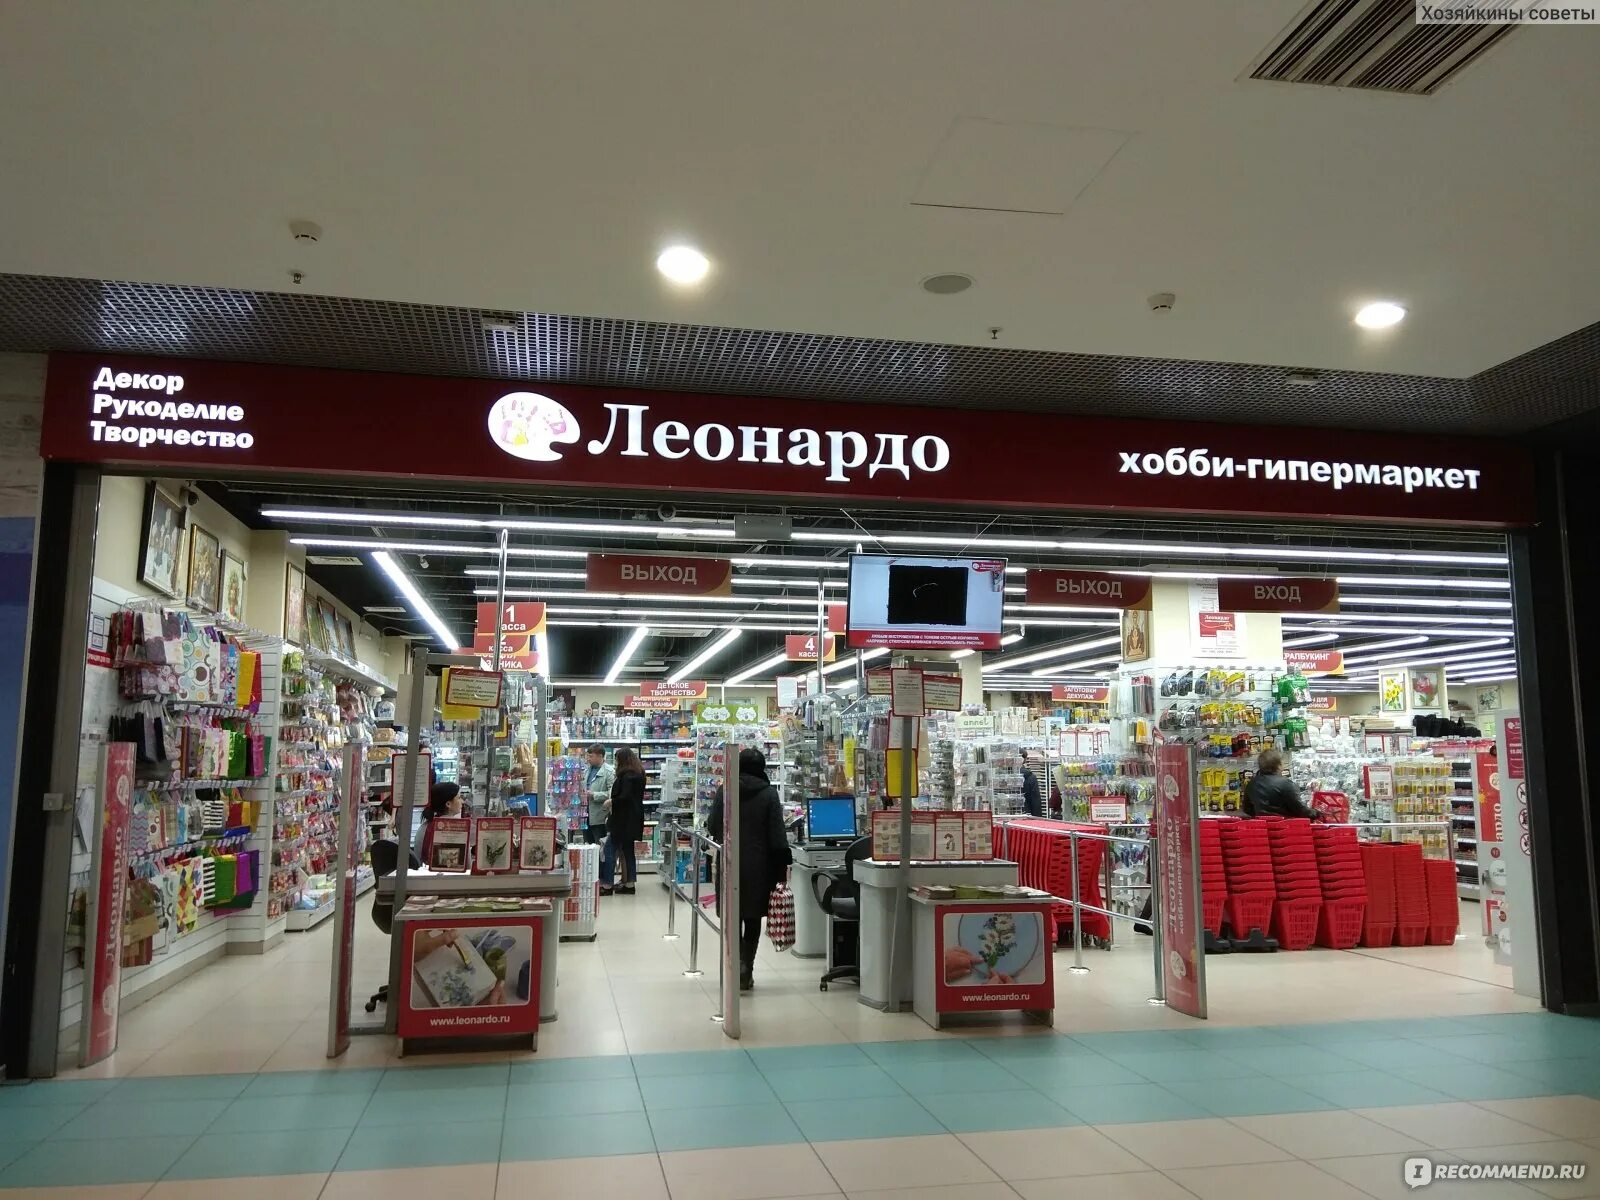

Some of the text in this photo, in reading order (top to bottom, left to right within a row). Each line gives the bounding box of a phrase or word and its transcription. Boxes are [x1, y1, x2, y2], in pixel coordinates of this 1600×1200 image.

[93, 366, 185, 395] Декор
[93, 393, 245, 422] Рукоделие
[90, 420, 255, 449] Творчество
[587, 402, 950, 482] Леонардо
[1118, 447, 1481, 493] хобби-гипермаркет
[621, 564, 698, 585] ВЫХОД
[1056, 578, 1123, 599] ВЫХОД
[1254, 585, 1301, 601] ВХОД
[506, 604, 515, 622] 1
[501, 623, 526, 631] асса
[804, 637, 815, 651] 4
[962, 992, 1030, 1002] www.leonardo.ru
[430, 1014, 511, 1027] www.leonardo.ru
